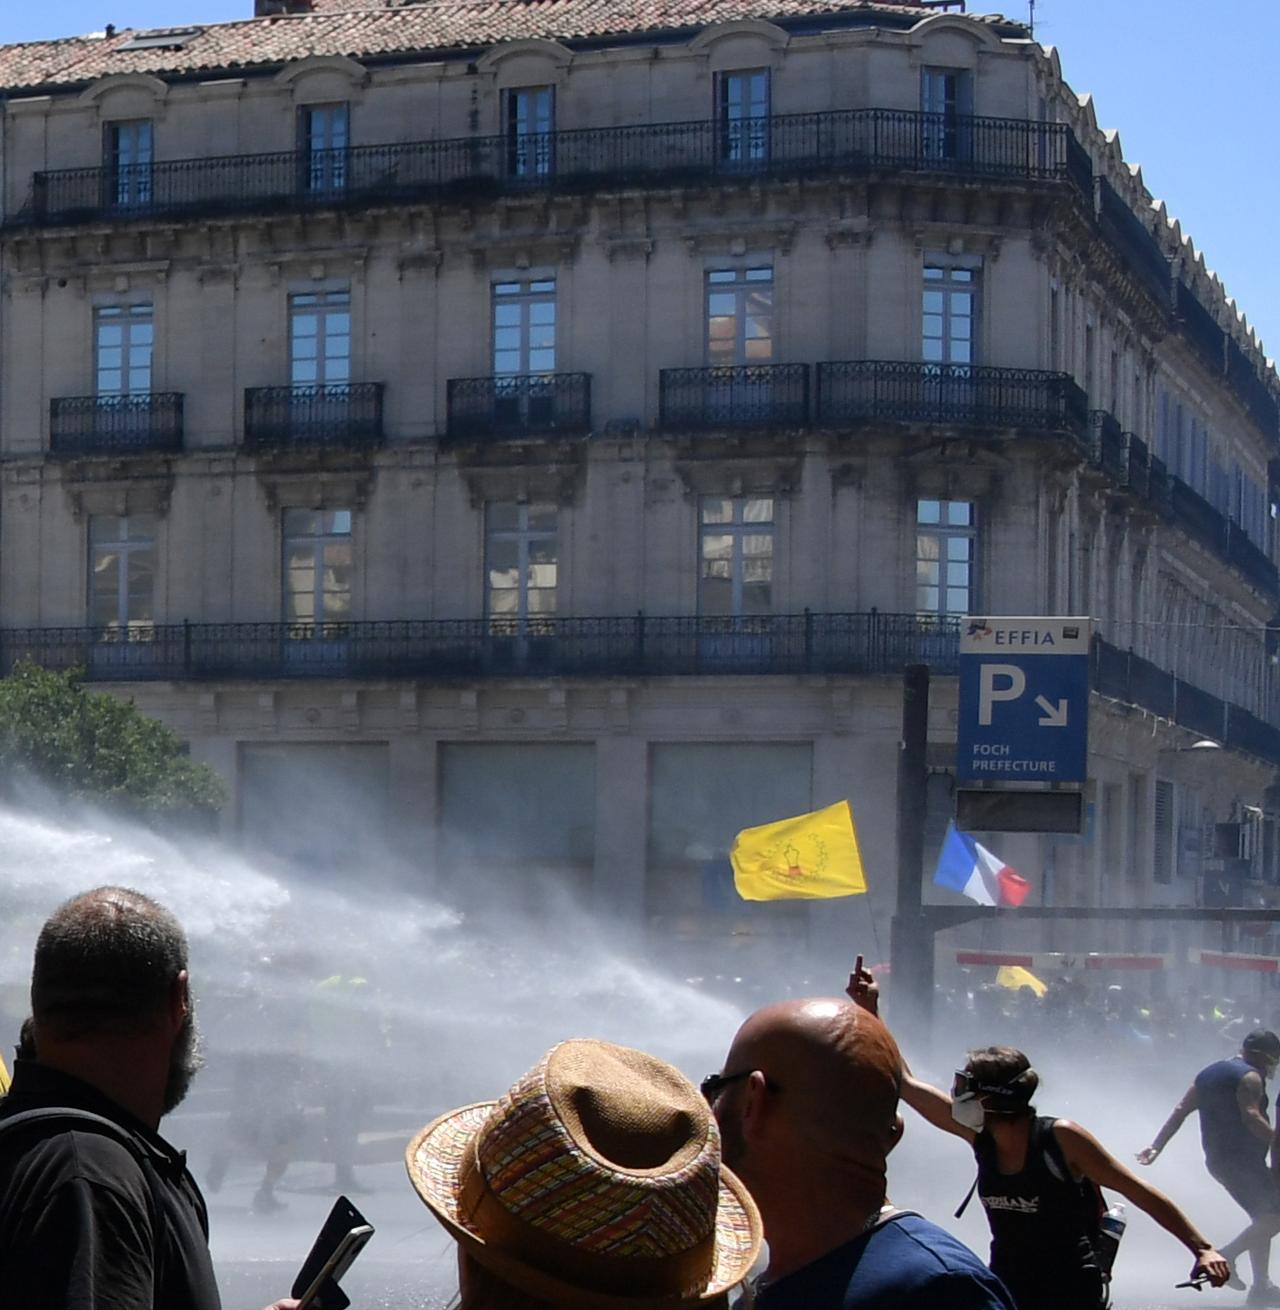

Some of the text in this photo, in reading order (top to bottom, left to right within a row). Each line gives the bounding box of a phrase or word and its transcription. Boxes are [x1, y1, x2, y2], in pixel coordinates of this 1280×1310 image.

[995, 630, 1055, 645] EFFIA
[979, 664, 1026, 725] P
[973, 744, 1010, 756] FOCH
[972, 760, 1056, 773] PREFECTURE
